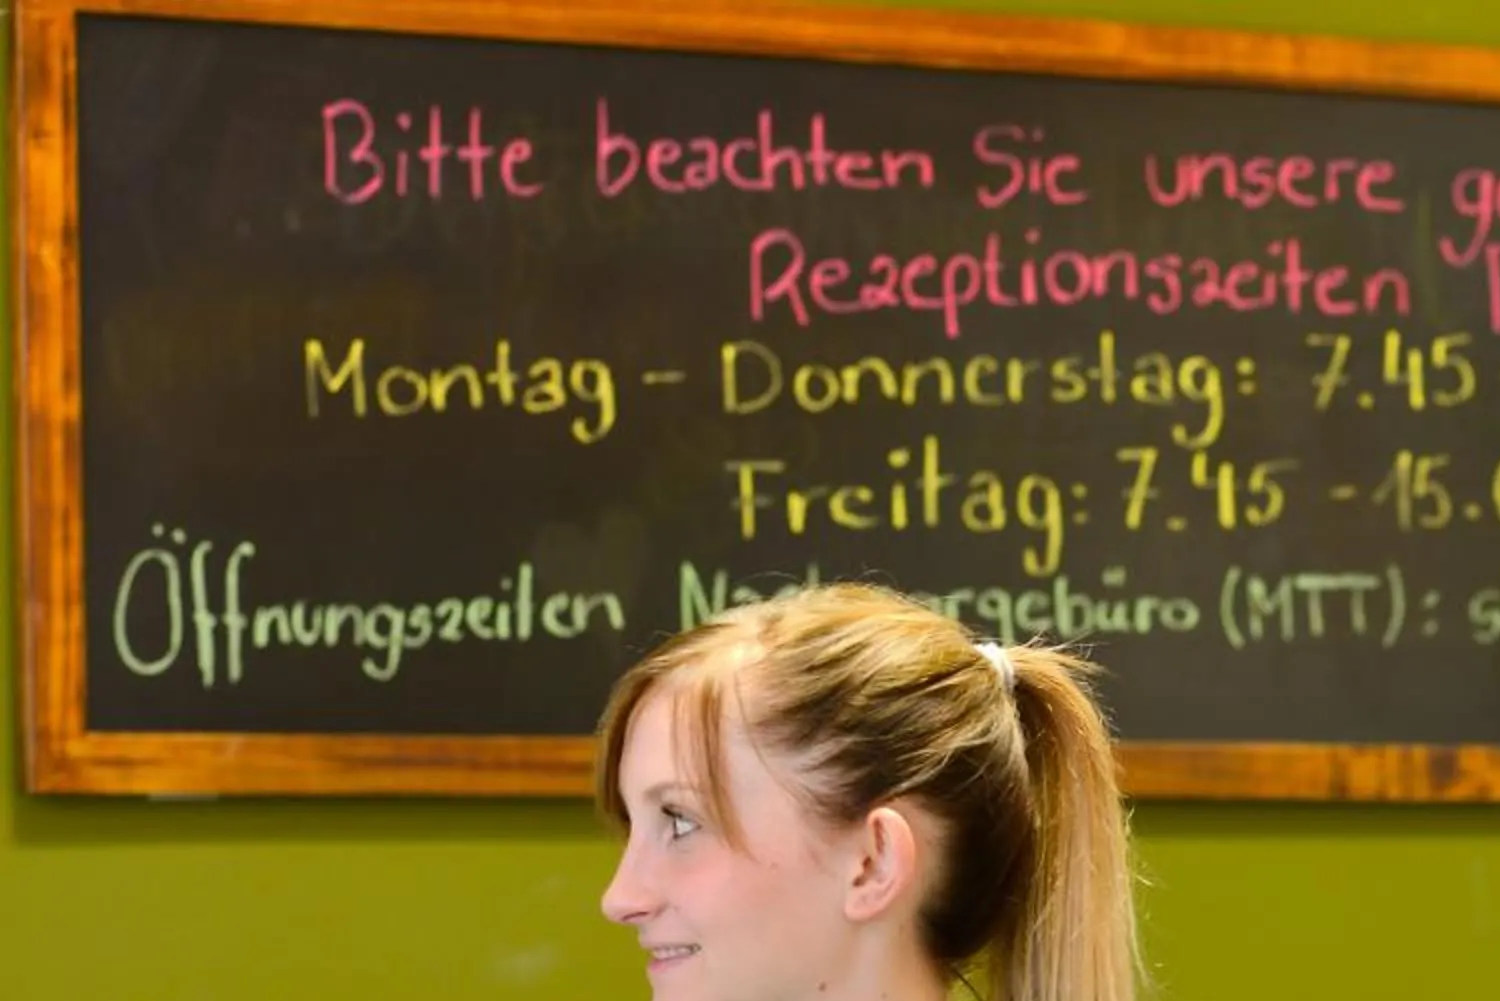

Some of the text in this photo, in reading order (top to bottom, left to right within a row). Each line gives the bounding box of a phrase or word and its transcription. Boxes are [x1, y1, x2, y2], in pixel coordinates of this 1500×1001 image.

[321, 98, 545, 206] Bitte
[596, 99, 937, 198] beachten
[973, 125, 1089, 210] Sie
[1144, 150, 1406, 214] unsere
[749, 225, 1412, 339] Rezeptionszeiten
[304, 338, 618, 444] Montag
[720, 330, 1258, 448] Donnerstag:
[1304, 328, 1477, 412] 7.45
[726, 434, 1092, 578] Freitag:
[1115, 446, 1299, 531] 7.45
[113, 523, 626, 686] Öffnungszeiten
[1220, 565, 1440, 648] (MTT):
